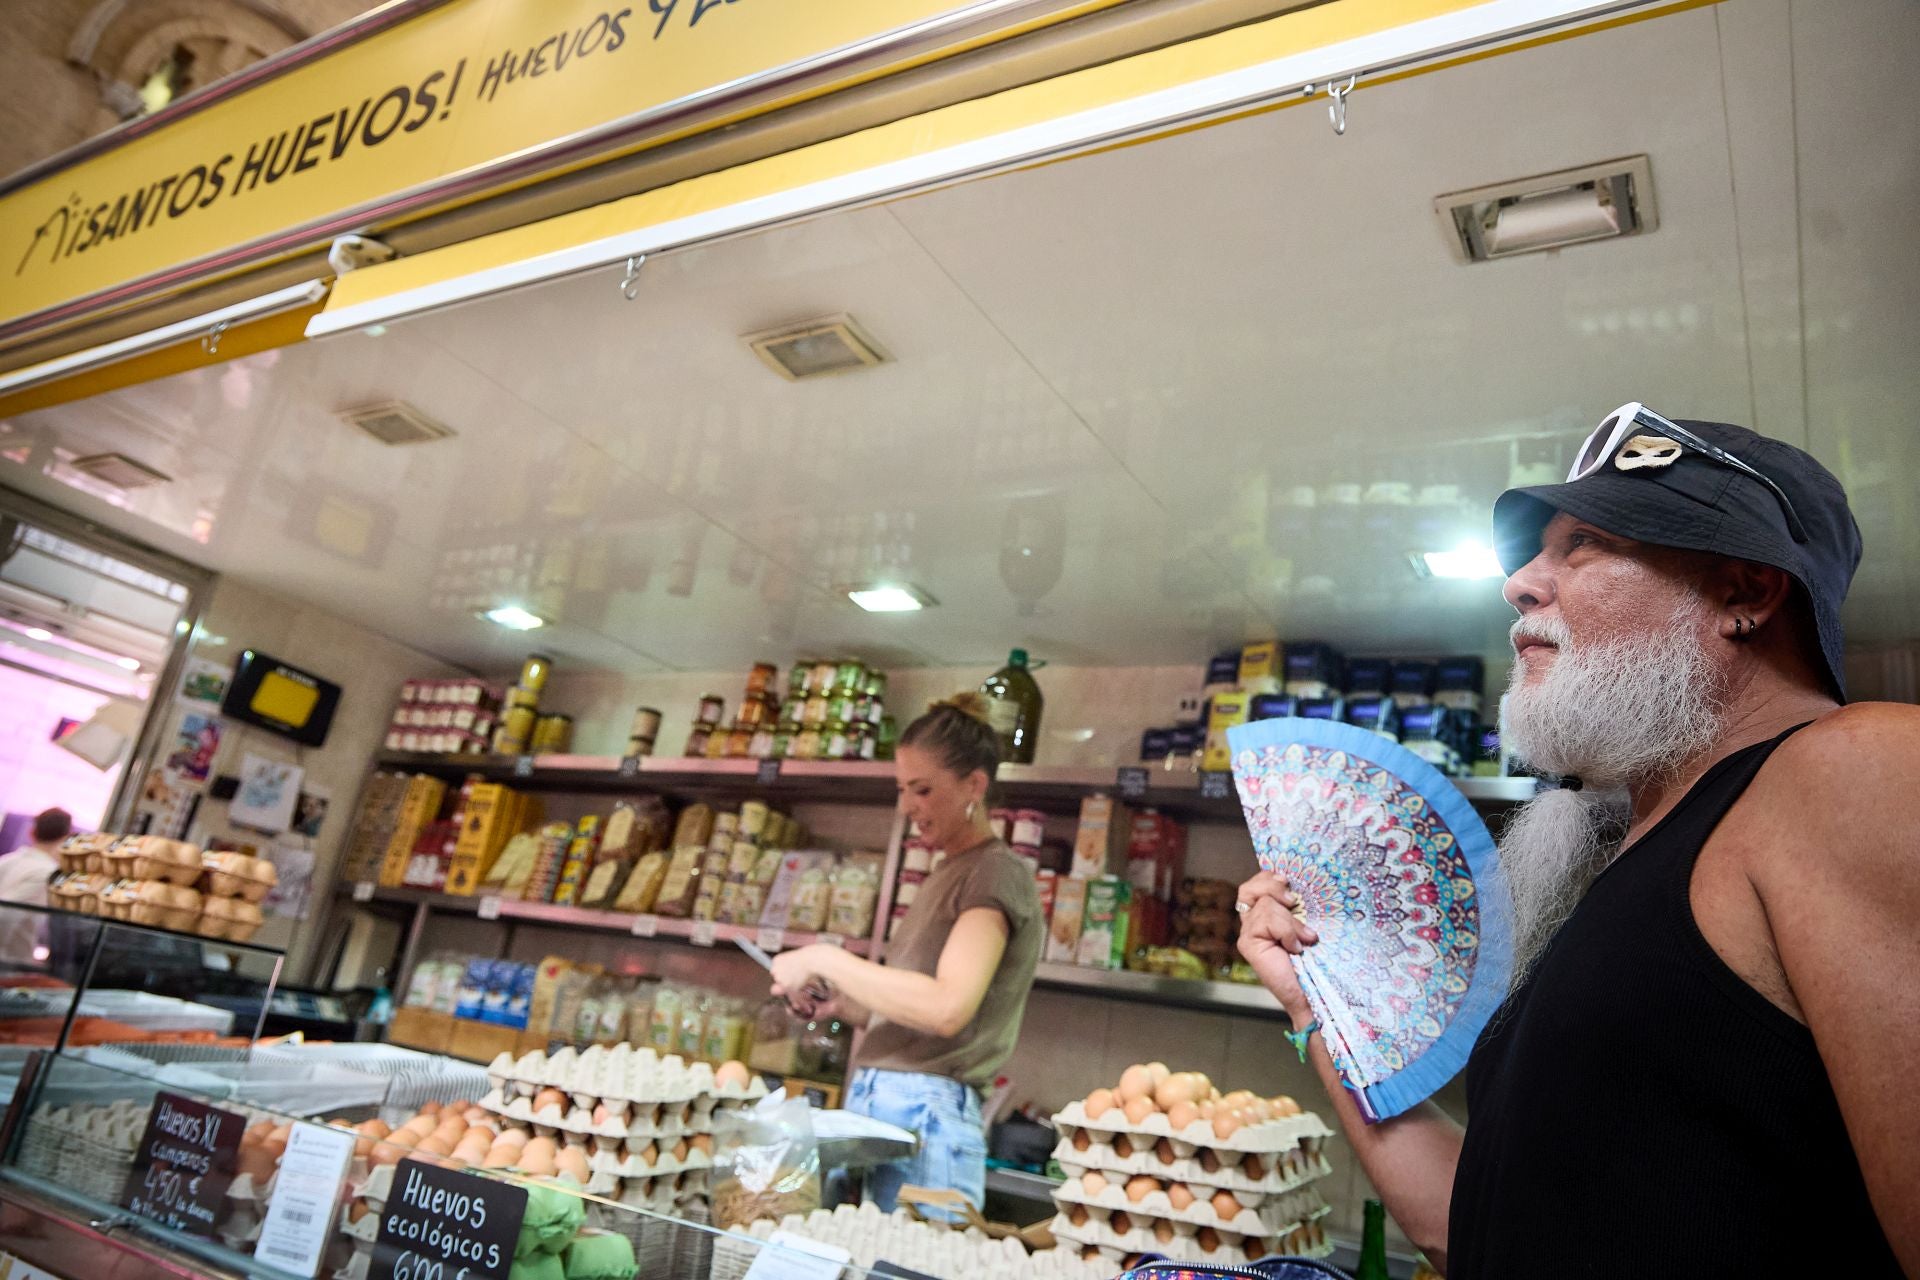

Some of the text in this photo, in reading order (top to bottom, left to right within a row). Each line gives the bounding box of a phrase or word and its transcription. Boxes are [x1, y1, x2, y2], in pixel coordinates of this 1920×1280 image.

[231, 58, 467, 197] HUEVOS!
[477, 8, 631, 102] HUEVOS
[155, 1101, 222, 1152] Huevos XL
[402, 1167, 486, 1229] Huevos
[387, 1214, 500, 1269] ecológicos
